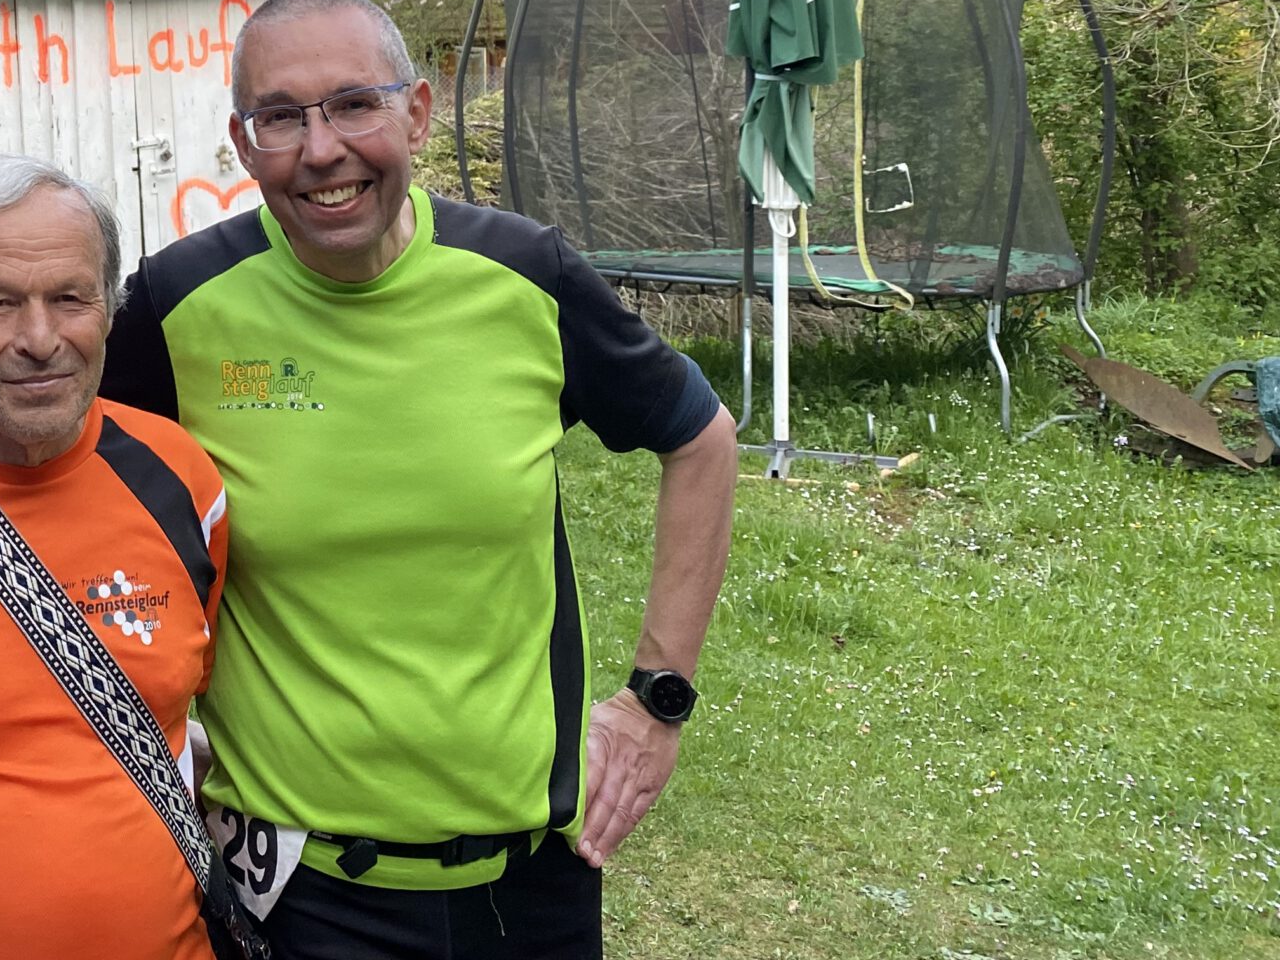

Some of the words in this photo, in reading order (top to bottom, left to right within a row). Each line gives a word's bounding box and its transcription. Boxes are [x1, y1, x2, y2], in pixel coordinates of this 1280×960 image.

[222, 360, 271, 380] Renn
[76, 591, 170, 615] Rennsteiglauf
[144, 621, 161, 631] 2010
[221, 806, 278, 895] 29
